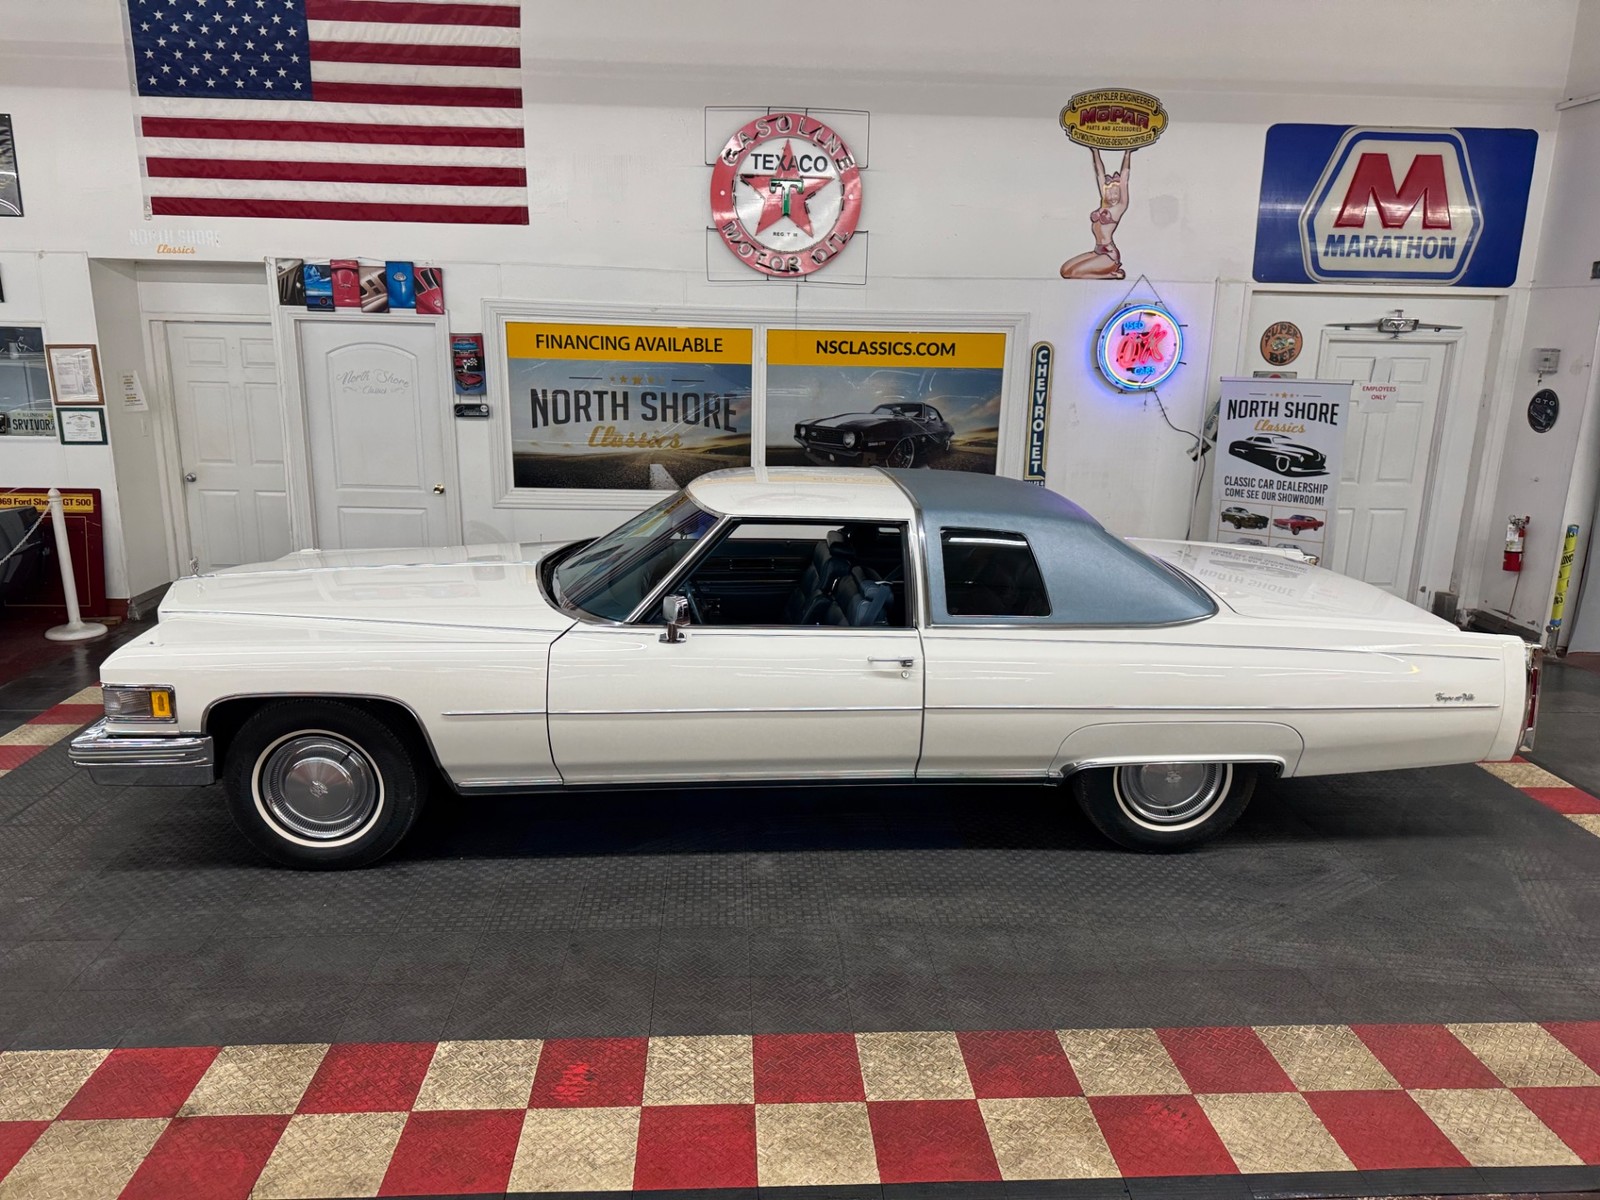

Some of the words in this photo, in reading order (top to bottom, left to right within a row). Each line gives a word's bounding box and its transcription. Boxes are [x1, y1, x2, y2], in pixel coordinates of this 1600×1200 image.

[1075, 96, 1087, 106] USE
[1089, 92, 1119, 102] CHRYSLER
[1120, 92, 1155, 108] ENGINEERED
[723, 115, 855, 173] GASOLINE
[750, 153, 828, 172] TEXACO
[769, 178, 804, 217] T
[1333, 153, 1452, 230] M
[156, 244, 196, 254] Classics
[722, 220, 801, 273] MOTOR
[812, 231, 850, 264] OIL
[1323, 234, 1457, 260] MARATHON
[1124, 321, 1144, 329] USED
[535, 334, 631, 351] FINANCING
[634, 336, 724, 353] AVAILABLE
[1264, 323, 1299, 347] SUPER
[816, 340, 956, 357] NSCLASSICS.COM
[1268, 347, 1296, 363] BEE
[1134, 366, 1155, 375] CARS
[530, 388, 630, 429] NORTH
[641, 391, 738, 433] SHORE
[1535, 397, 1555, 406] GTO
[1031, 349, 1049, 474] CHEVROLET
[1227, 399, 1279, 420] NORTH
[1285, 401, 1340, 426] SHORE
[12, 419, 51, 431] SRVIVOR
[1254, 419, 1306, 434] Classics
[588, 425, 684, 450] Classics
[1224, 475, 1256, 488] CLASSIC
[1258, 478, 1274, 489] CAR
[1276, 480, 1328, 495] DEALERSHIP
[33, 498, 50, 506] She
[1225, 488, 1245, 499] COME
[1246, 490, 1259, 500] SEE
[1261, 491, 1276, 501] OUR
[1277, 492, 1325, 506] SHOWROOM!
